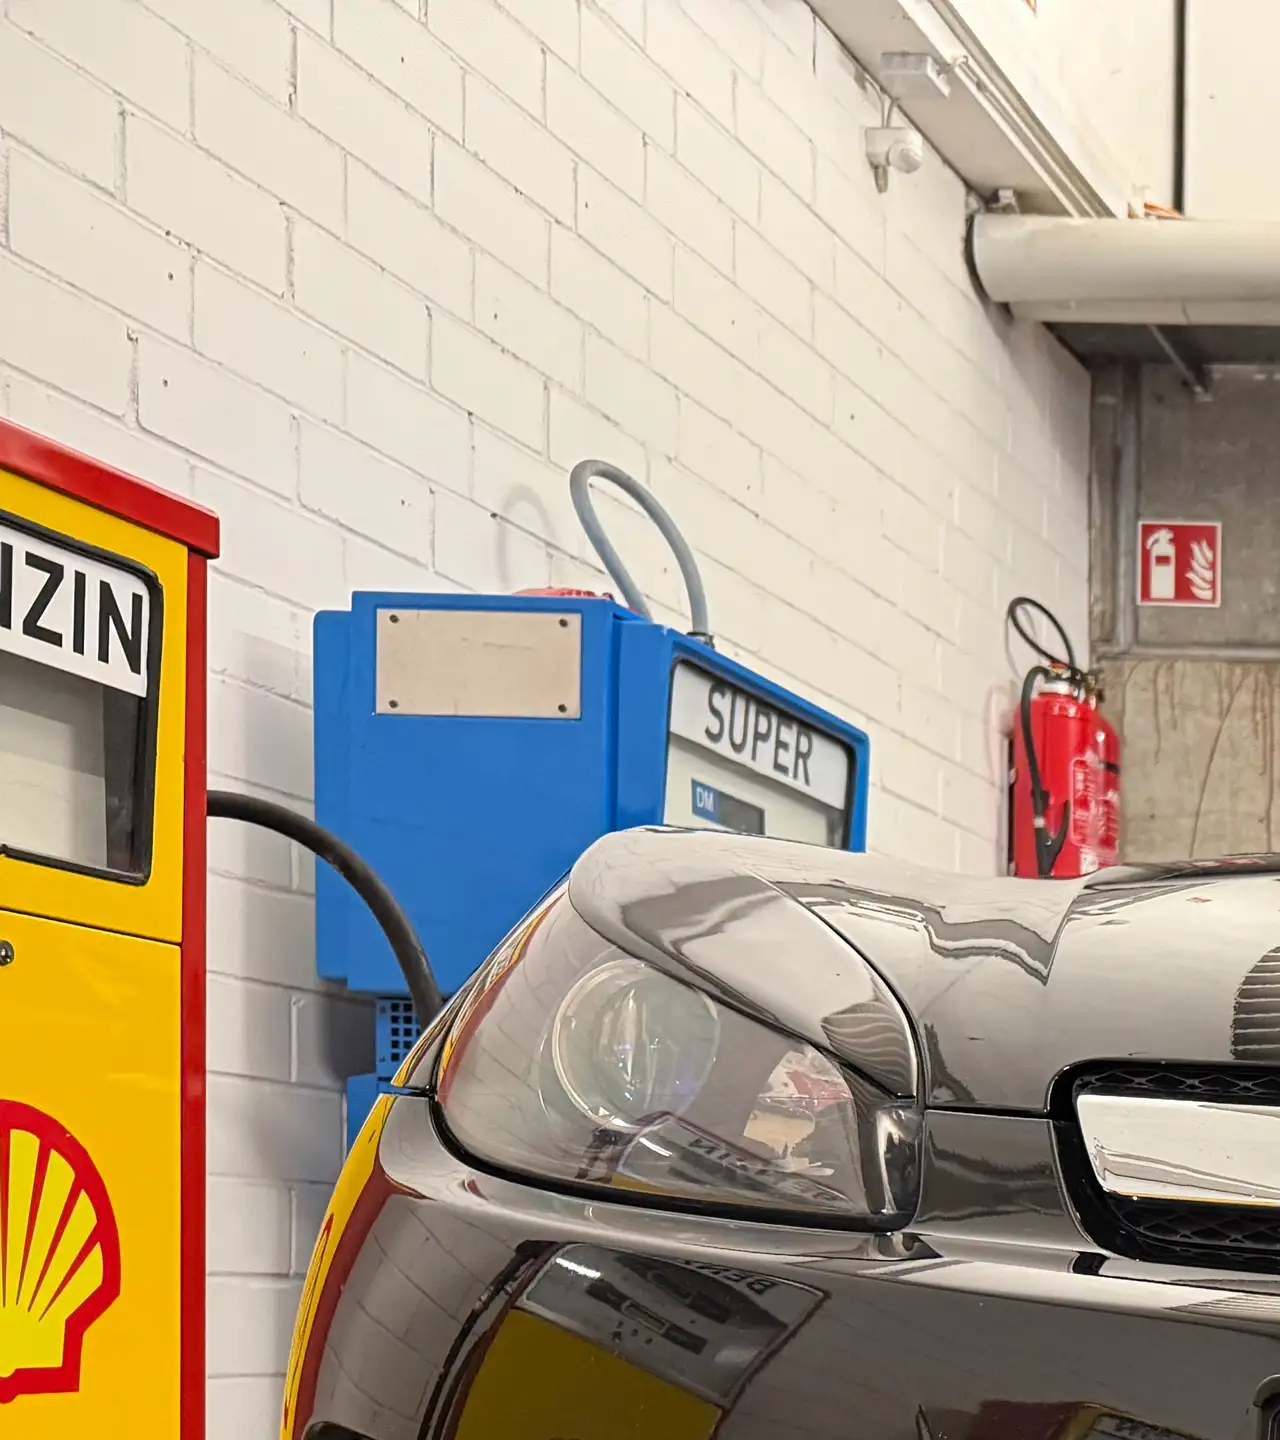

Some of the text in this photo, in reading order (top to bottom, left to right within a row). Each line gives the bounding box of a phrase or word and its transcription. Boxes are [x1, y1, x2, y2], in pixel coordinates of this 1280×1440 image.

[0, 541, 144, 675] ZIN
[704, 682, 814, 787] SUPER
[696, 786, 715, 813] DM
